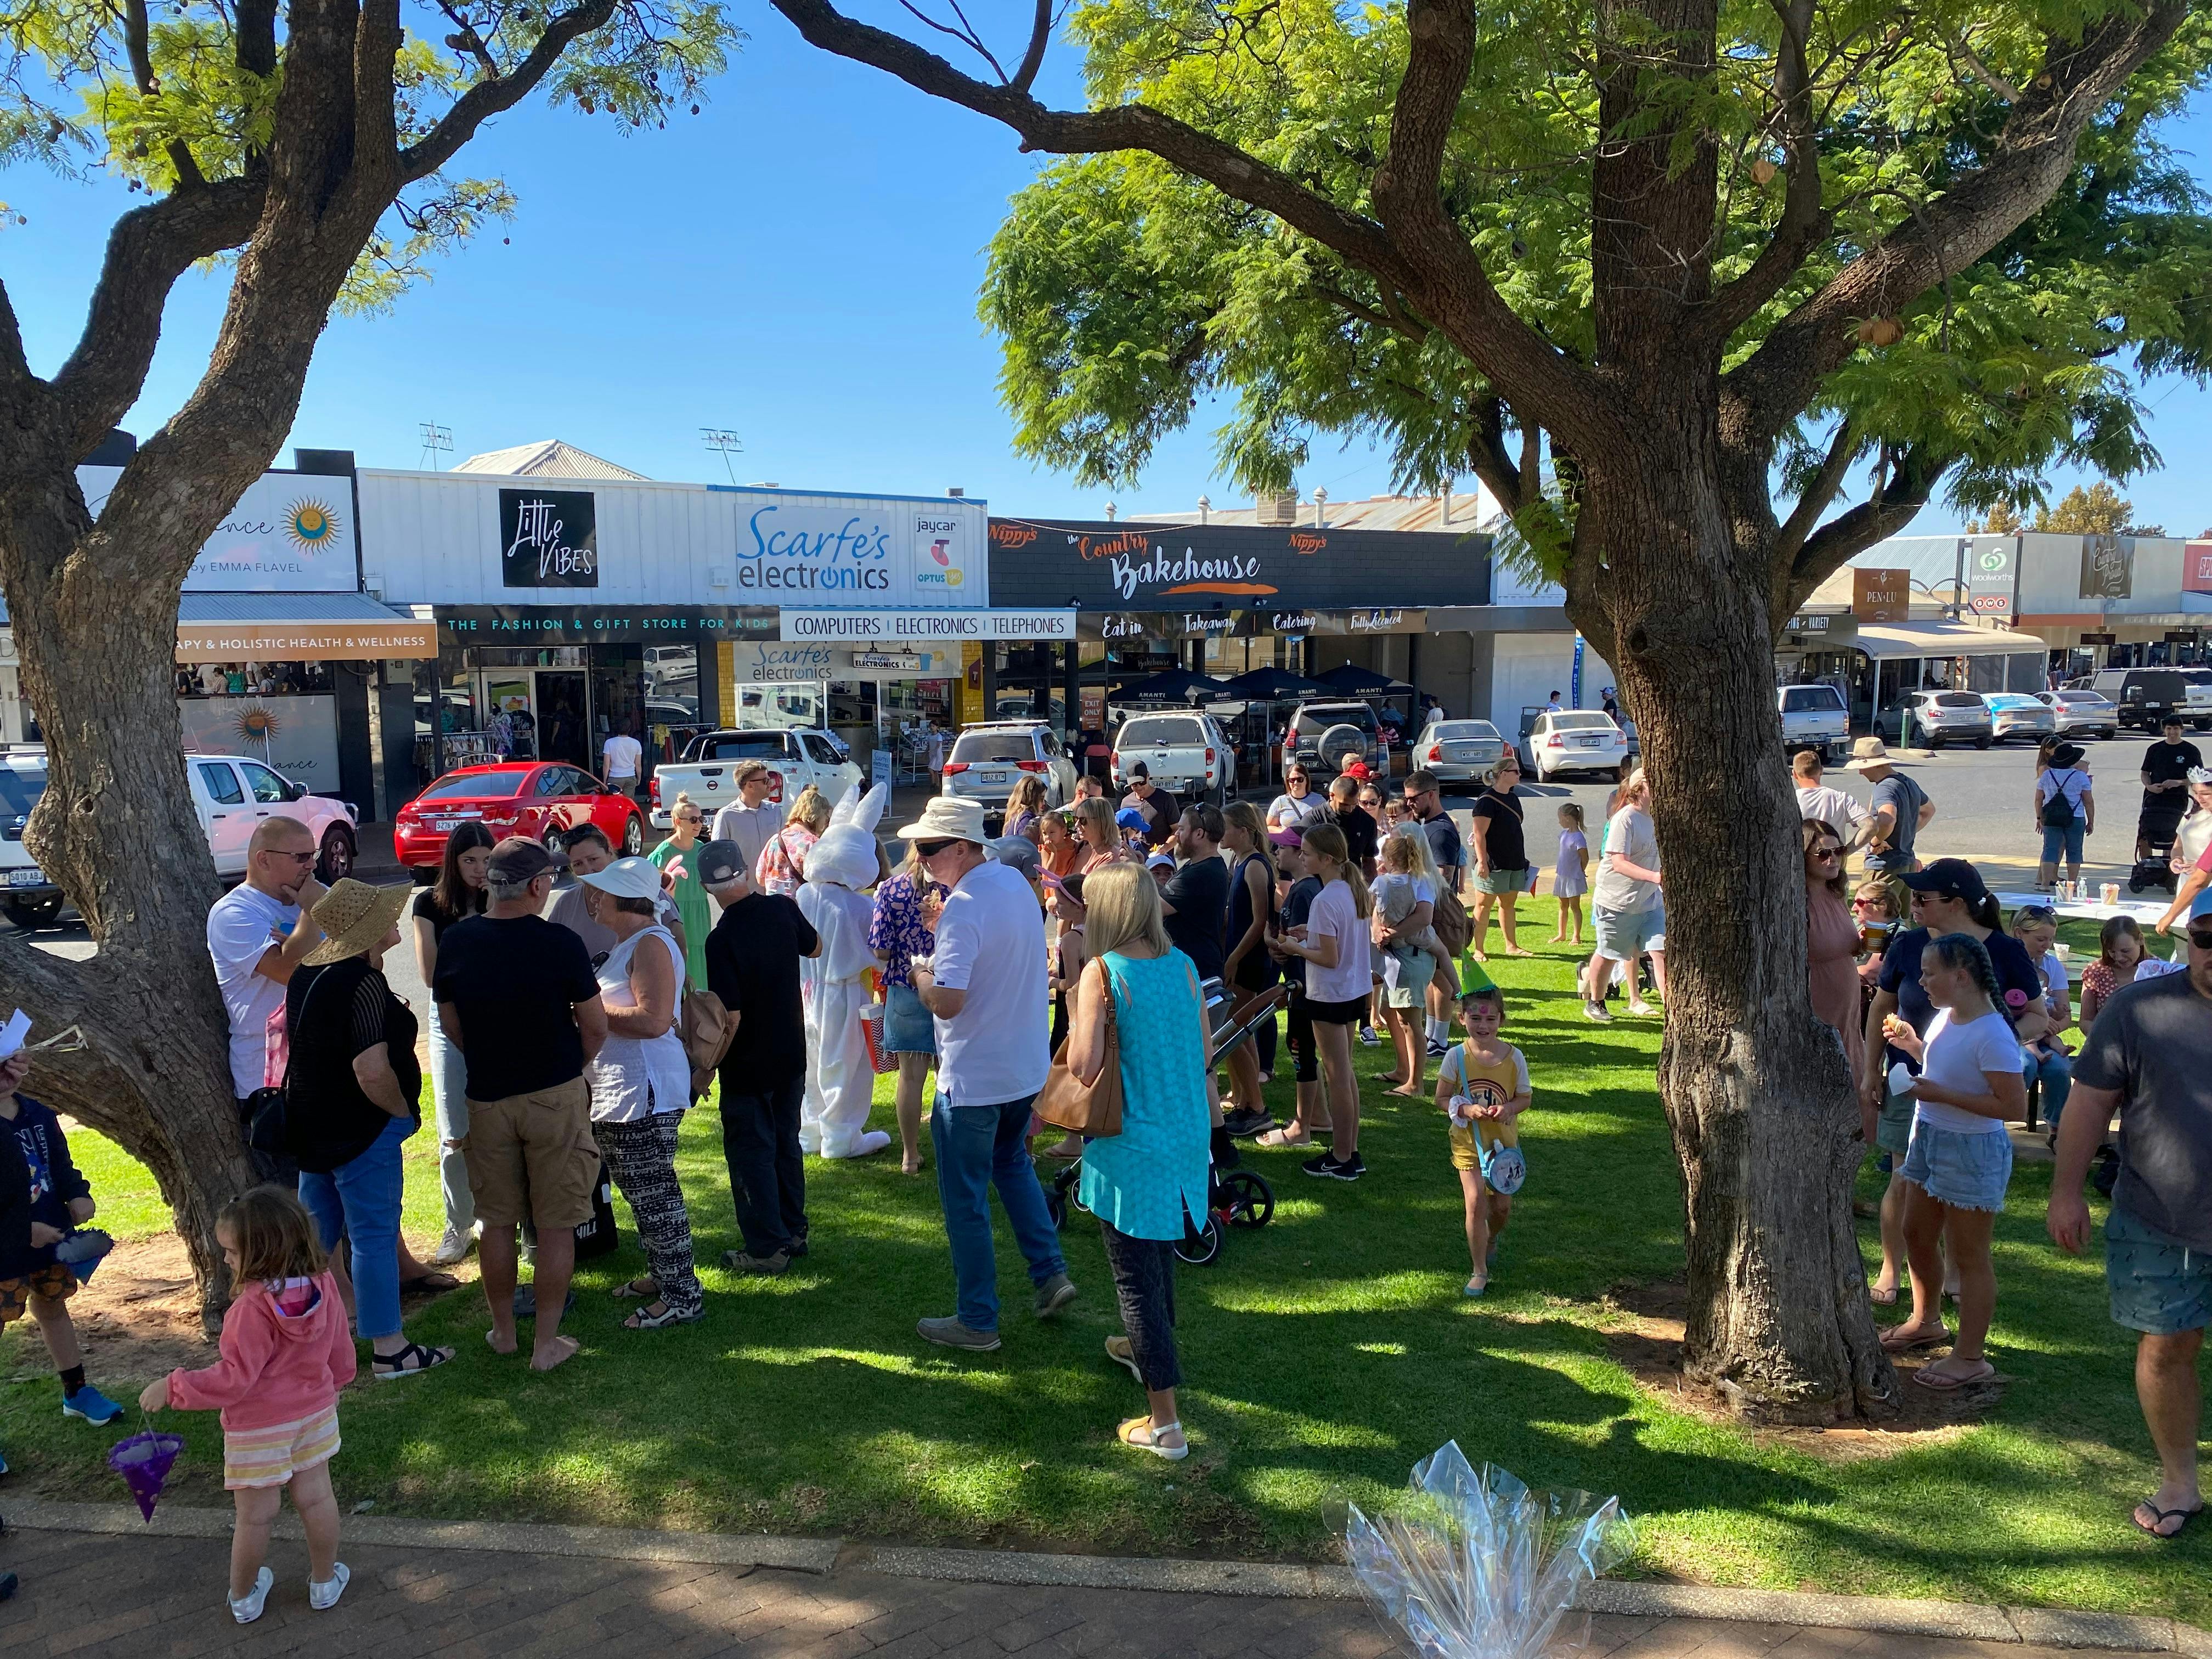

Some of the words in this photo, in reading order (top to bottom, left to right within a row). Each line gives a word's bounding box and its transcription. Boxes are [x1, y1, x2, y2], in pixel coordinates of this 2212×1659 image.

[507, 499, 563, 557] Little
[917, 517, 956, 533] jaycar
[737, 506, 890, 563] Scarfe's
[989, 524, 1038, 548] Nippy's
[1066, 534, 1079, 544] the
[1078, 531, 1148, 561] Country
[1287, 534, 1327, 554] Nippy's
[210, 562, 251, 572] EMMA
[256, 562, 303, 572] FLAVEL
[539, 539, 592, 578] VIBES
[739, 557, 889, 589] electronics
[917, 574, 945, 583] OPTUS
[1109, 545, 1261, 600] Bakehouse
[1972, 573, 2014, 582] woolworths
[1867, 591, 1883, 603] PEN
[1886, 591, 1897, 603] LU
[448, 620, 477, 630] THE
[493, 619, 563, 630] FASHION
[574, 619, 583, 630] &
[593, 619, 630, 629] GIFT
[642, 619, 686, 629] STORE
[700, 619, 724, 629] FOR
[735, 619, 768, 628] KIDS
[795, 618, 881, 635] COMPUTERS
[896, 618, 978, 634] ELECTRONICS
[991, 618, 1064, 634] TELEPHONES
[1102, 616, 1127, 638] Eat
[1130, 621, 1144, 634] in
[1183, 613, 1237, 634] Takeaway
[1272, 613, 1317, 631] Catering
[1351, 614, 1370, 632] Fully
[1808, 617, 1830, 629] VARIETY
[206, 640, 216, 649] &
[220, 639, 286, 649] HOLISTIC
[290, 637, 341, 648] HEALTH
[346, 638, 354, 647] &
[358, 636, 426, 647] WELLNESS
[752, 641, 832, 666] Scarfe's
[753, 665, 832, 680] electronics
[855, 660, 900, 668] ELECTRONICS
[29, 871, 43, 879] ABJ
